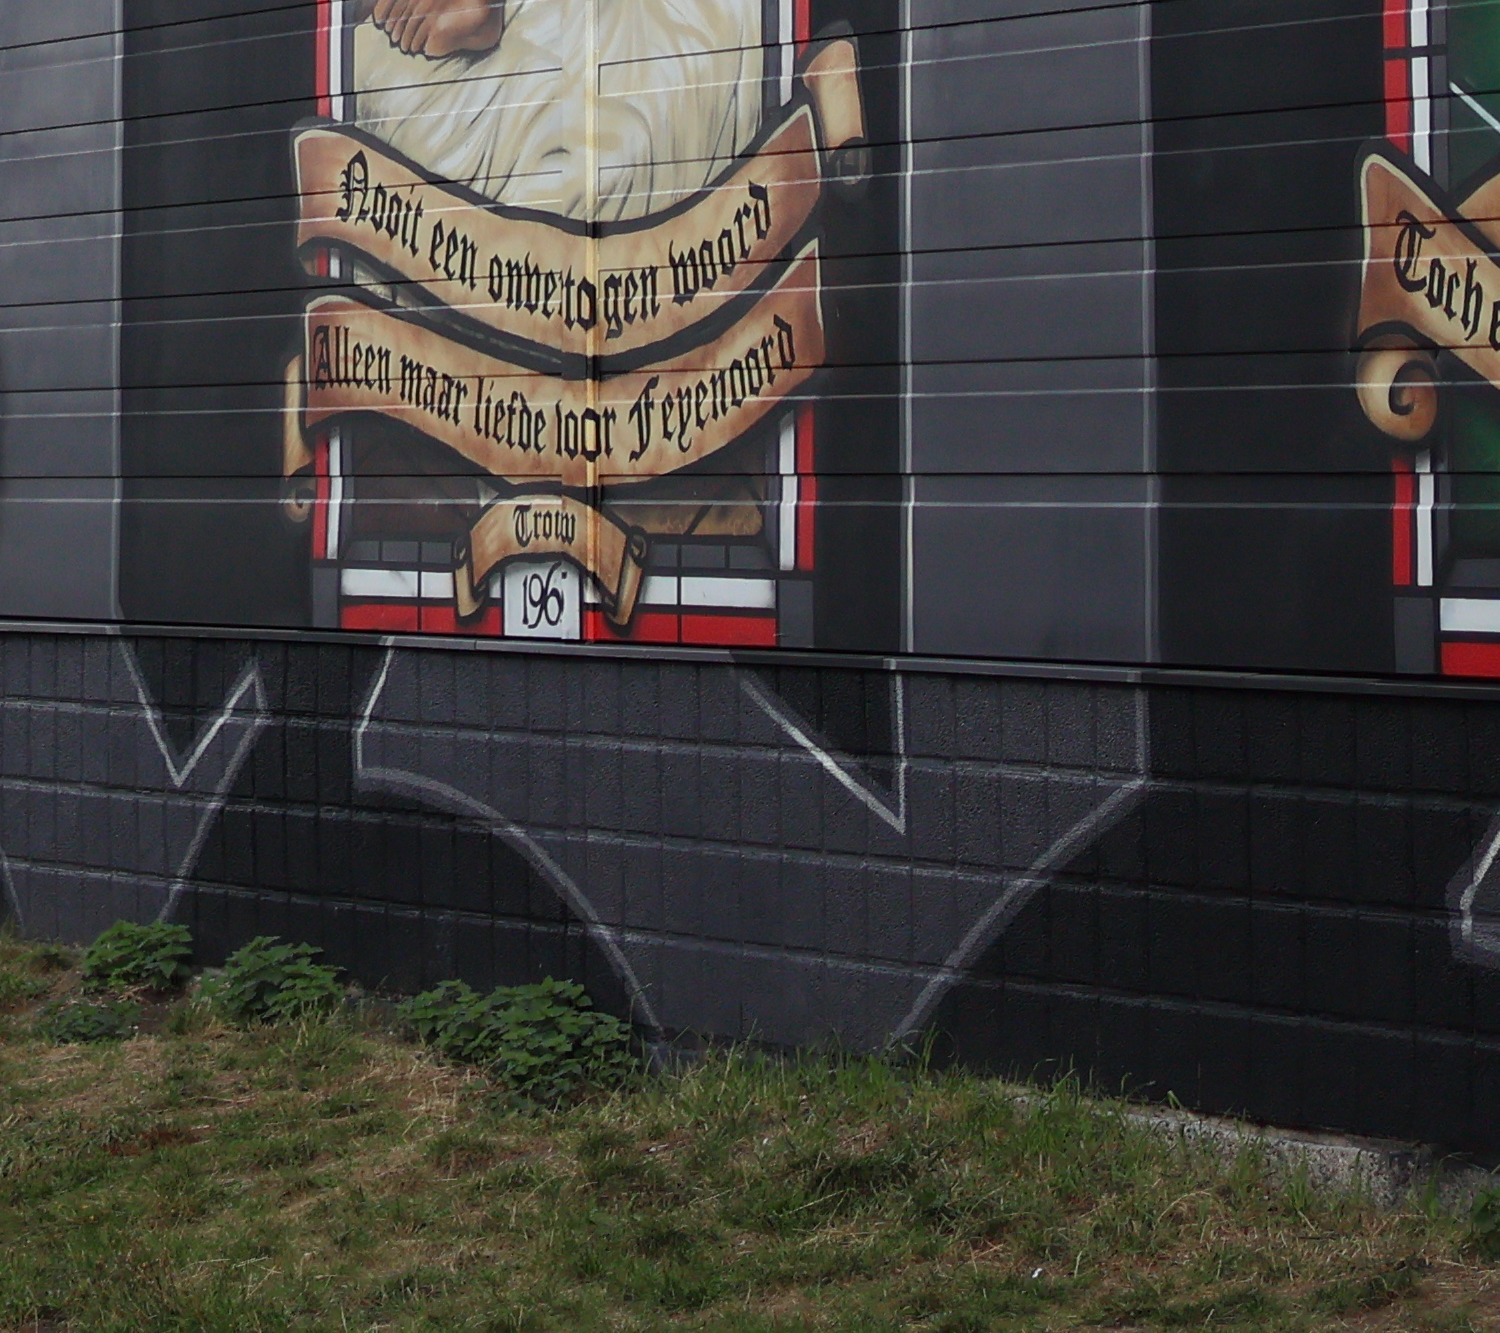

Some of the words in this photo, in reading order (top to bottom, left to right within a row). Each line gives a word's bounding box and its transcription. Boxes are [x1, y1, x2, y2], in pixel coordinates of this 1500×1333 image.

[334, 149, 424, 263] Nooit
[429, 217, 478, 290] een
[669, 179, 773, 303] woord
[1393, 209, 1484, 330] Toch
[313, 324, 392, 395] Alleen
[399, 353, 468, 429] maar
[473, 377, 547, 456] liefde
[628, 313, 797, 463] Feyenoord
